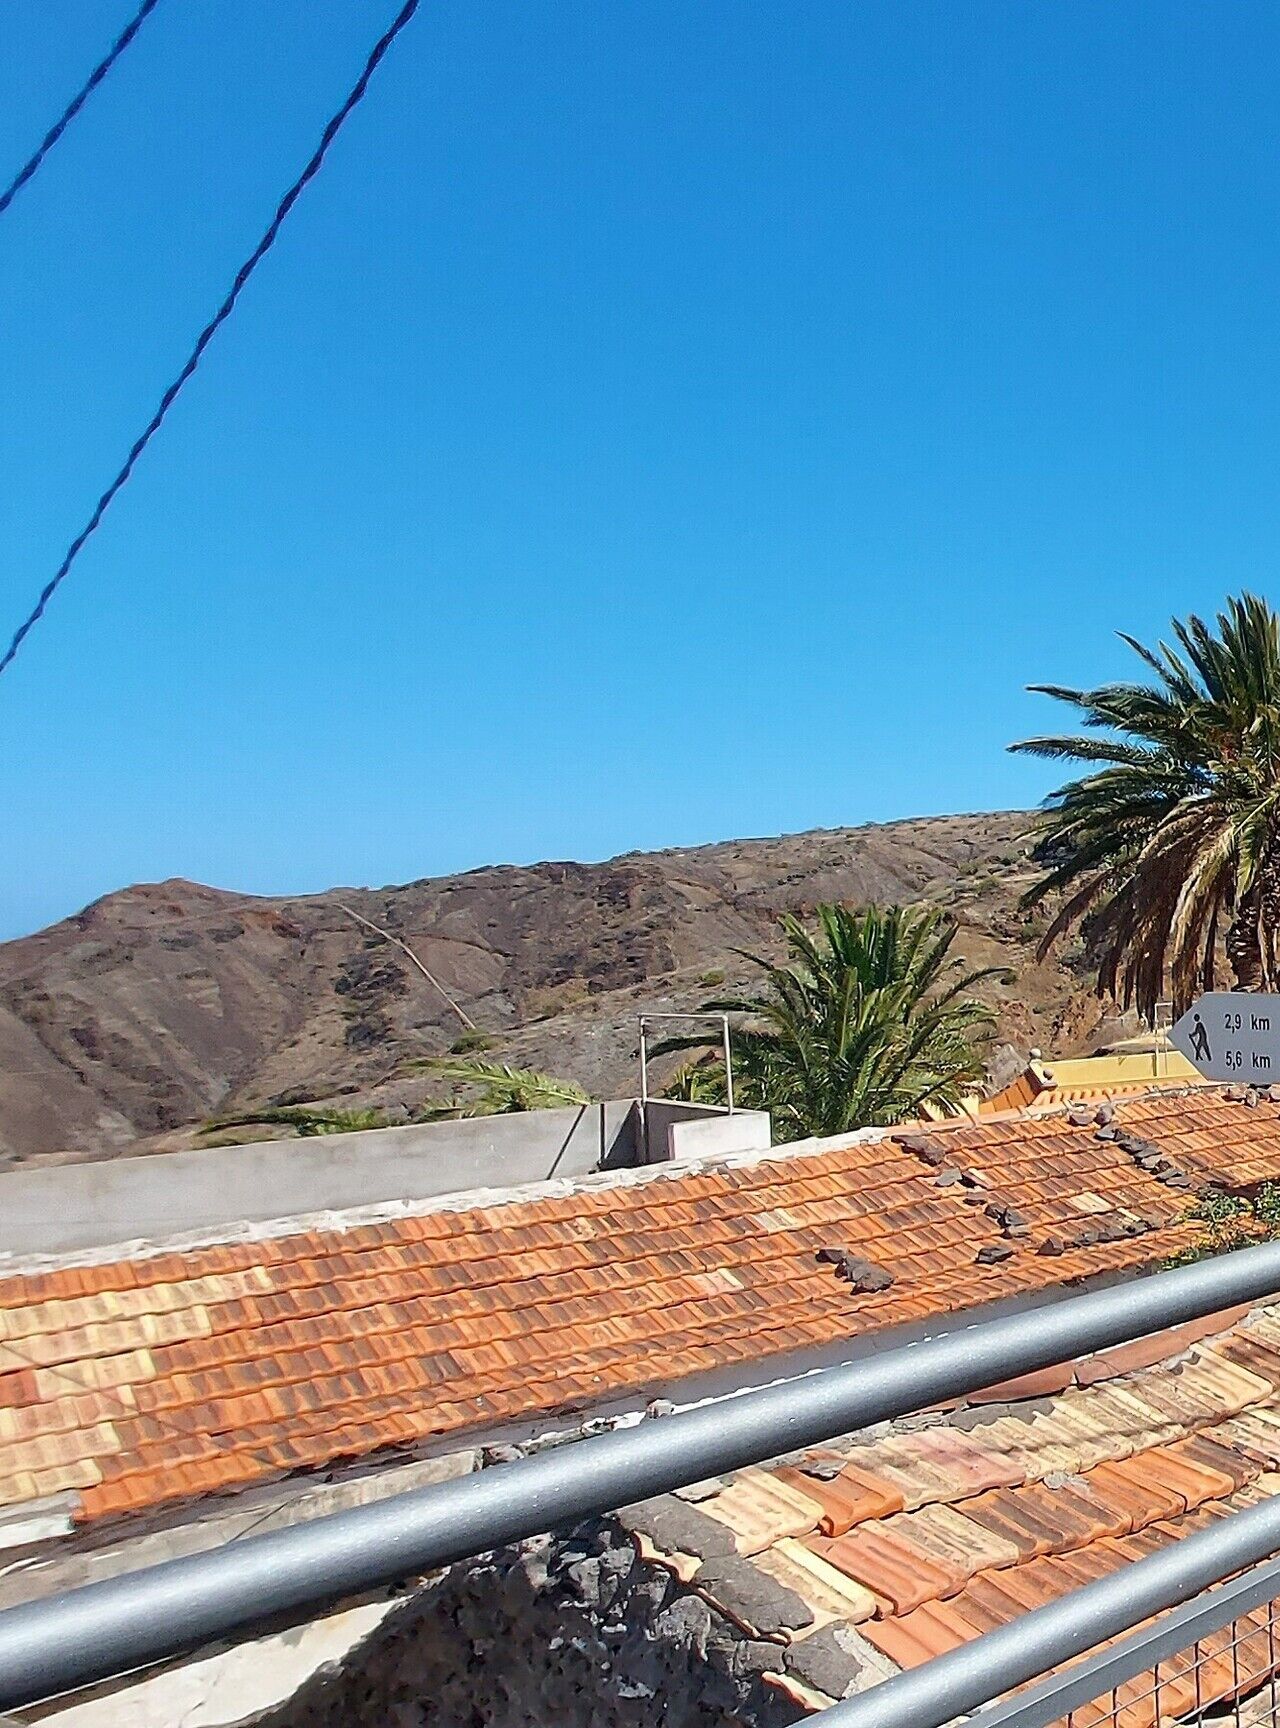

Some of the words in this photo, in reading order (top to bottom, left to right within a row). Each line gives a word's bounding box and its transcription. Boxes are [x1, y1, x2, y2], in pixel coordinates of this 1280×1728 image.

[1224, 1013, 1242, 1034] 2,9
[1251, 1014, 1270, 1031] km
[1225, 1051, 1243, 1071] 5,6
[1252, 1052, 1271, 1069] km
